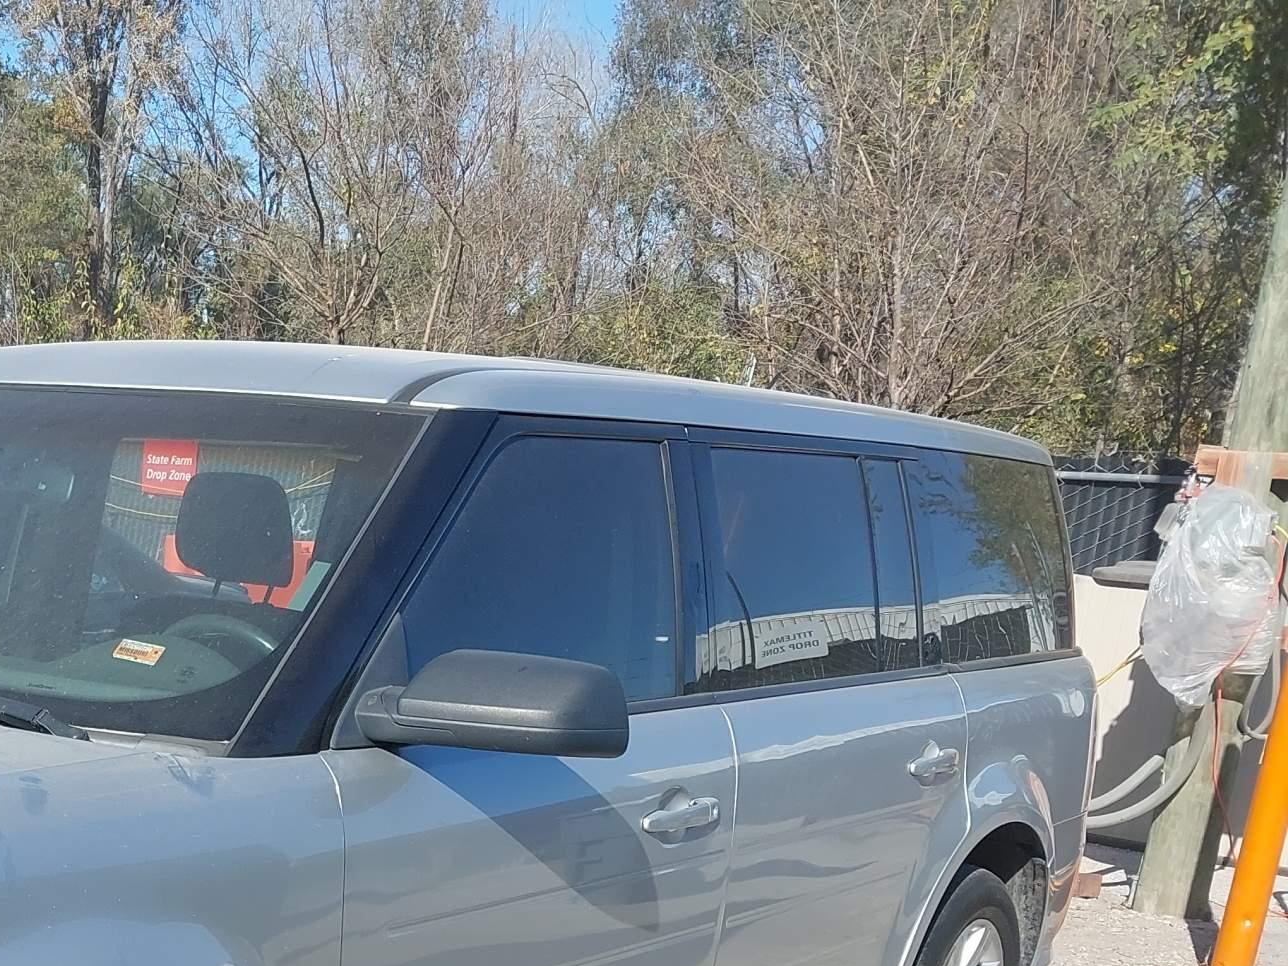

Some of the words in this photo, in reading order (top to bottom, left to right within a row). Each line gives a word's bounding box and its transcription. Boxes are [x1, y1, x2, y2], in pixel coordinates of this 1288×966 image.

[146, 454, 169, 465] State
[170, 455, 193, 466] Farm
[146, 468, 168, 482] Drop
[168, 469, 192, 482] Zone
